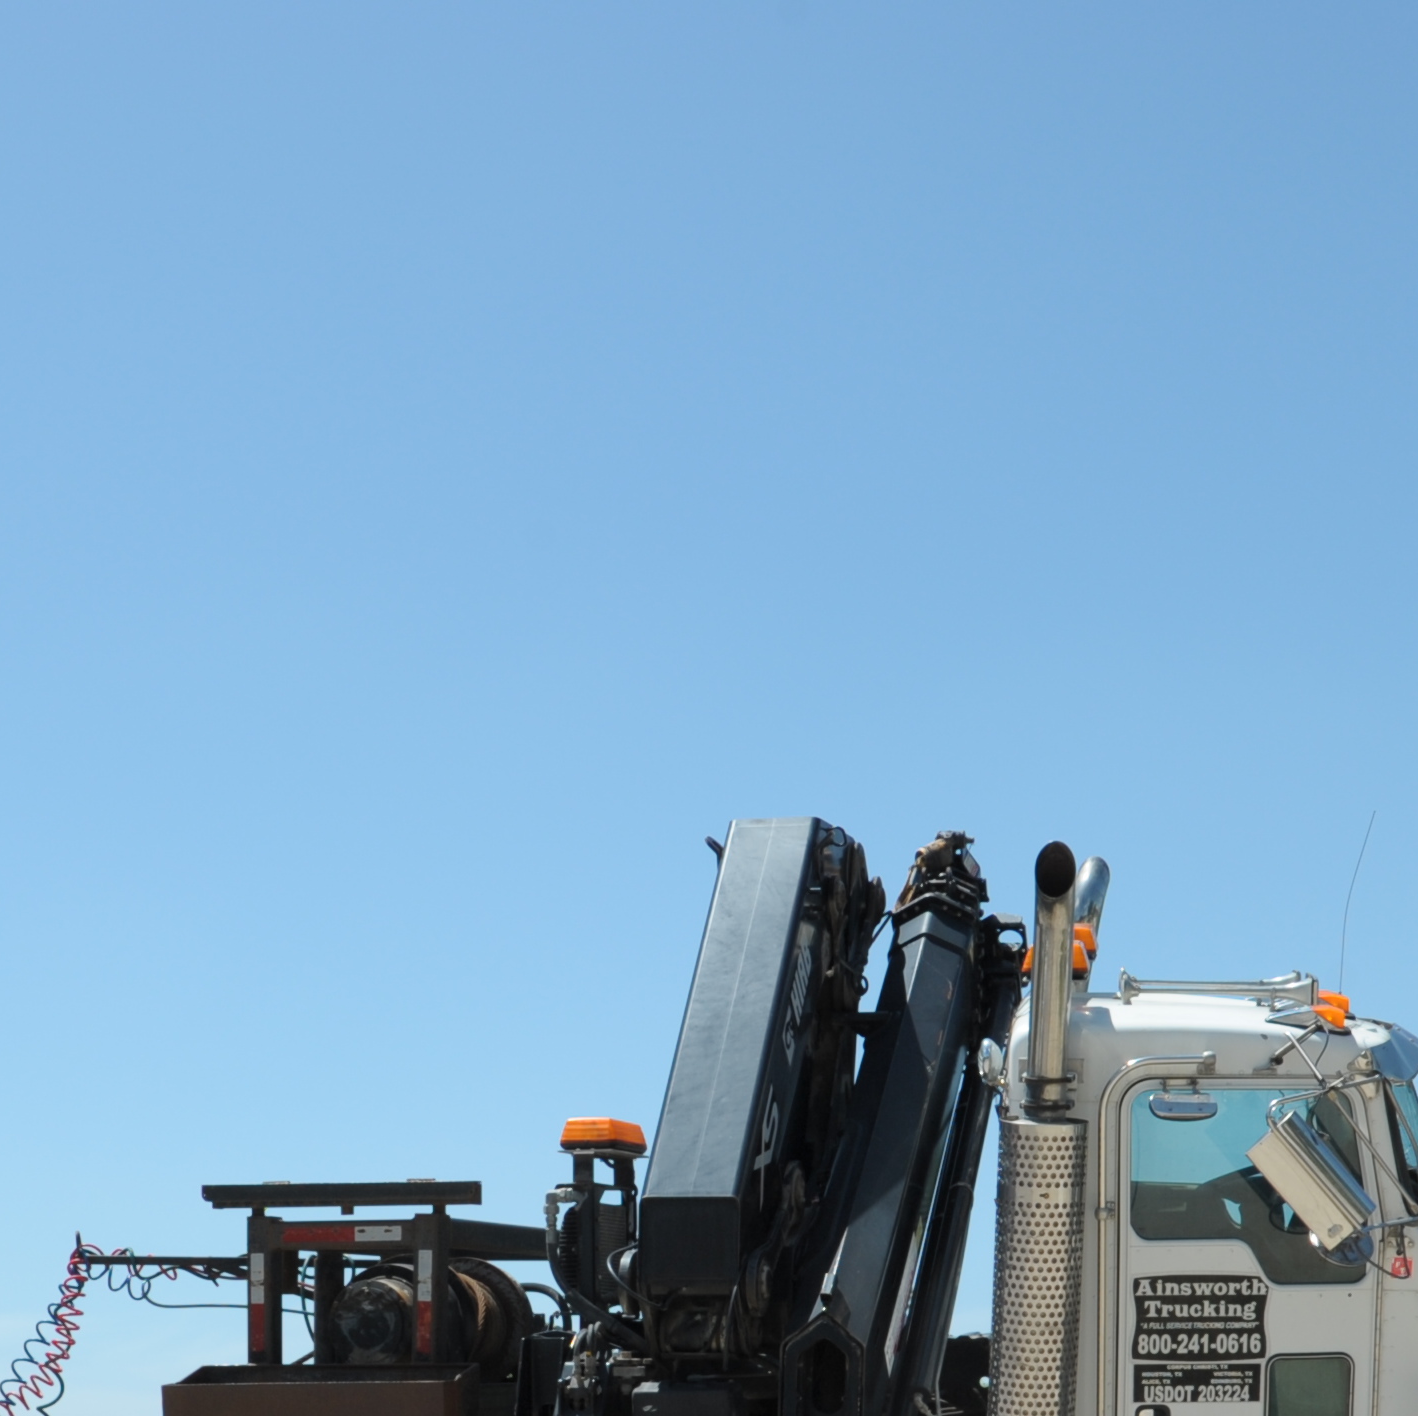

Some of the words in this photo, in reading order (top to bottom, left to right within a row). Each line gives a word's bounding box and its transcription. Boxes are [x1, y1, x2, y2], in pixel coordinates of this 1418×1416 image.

[1135, 1279, 1267, 1296] Ainsworth
[1144, 1300, 1257, 1320] Trucking
[1137, 1333, 1262, 1354] 800-241-0616
[1144, 1385, 1194, 1402] USDOT
[1198, 1384, 1250, 1402] 203224
